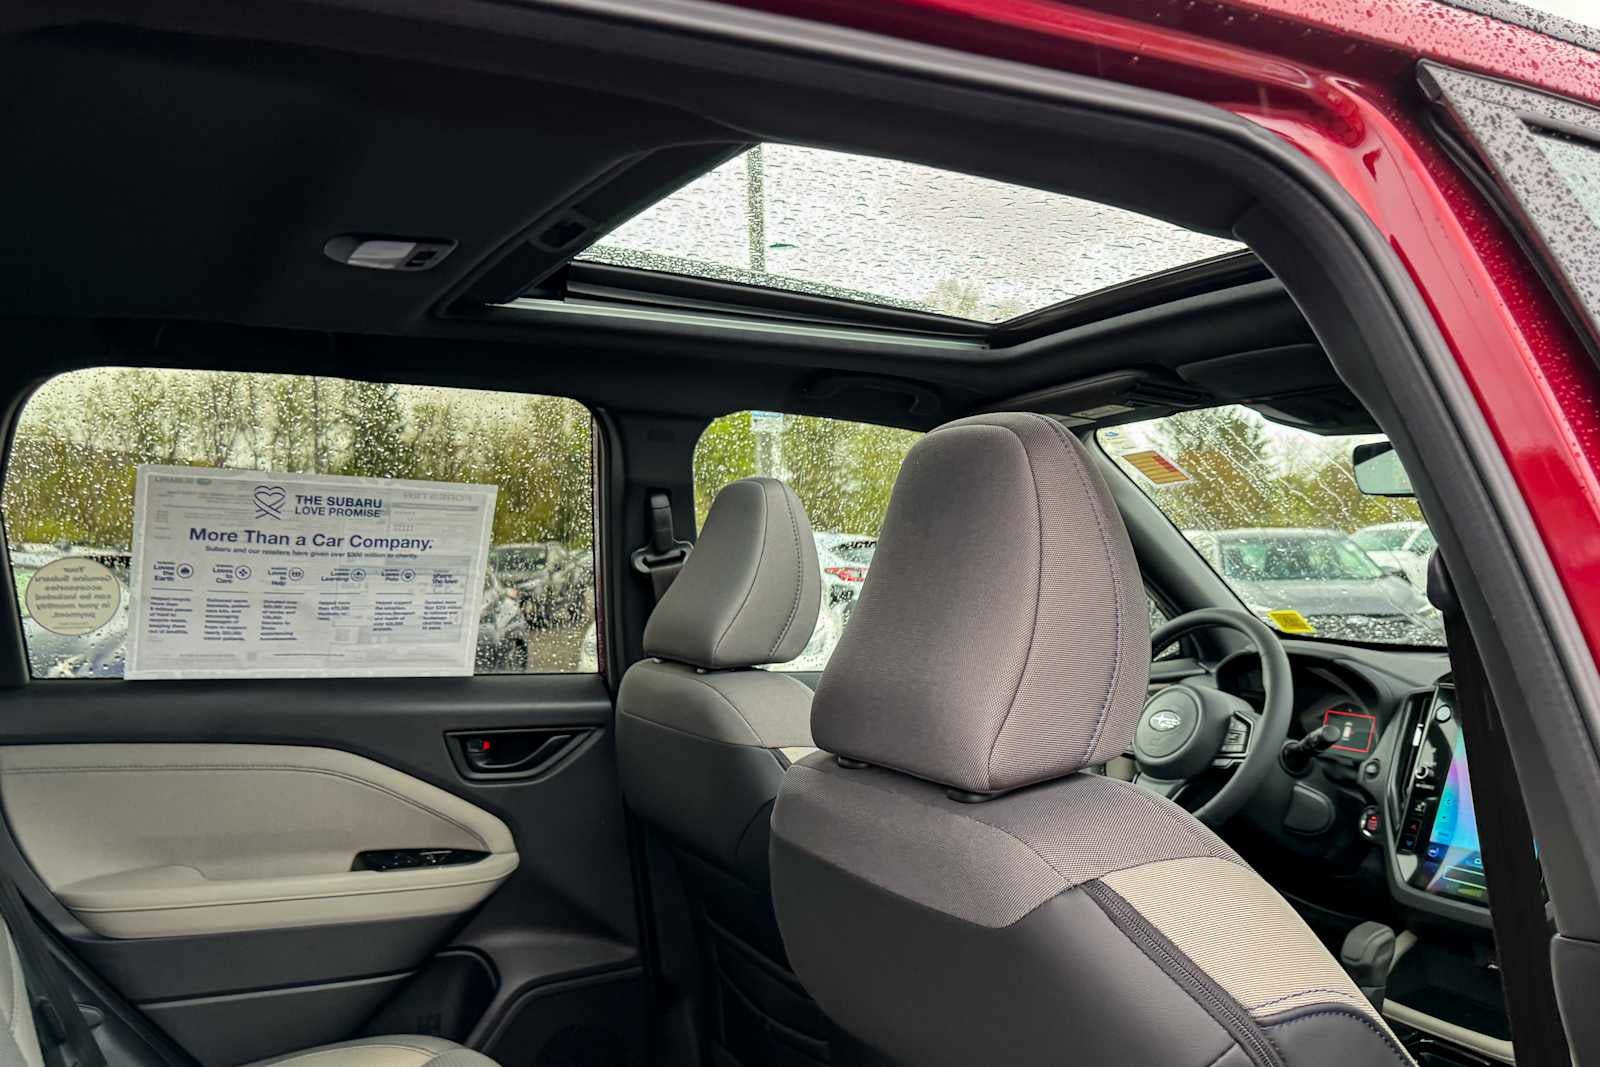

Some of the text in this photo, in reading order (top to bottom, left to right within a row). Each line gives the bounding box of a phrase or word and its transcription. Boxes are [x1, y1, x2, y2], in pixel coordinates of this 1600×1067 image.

[295, 494, 383, 509] THE SUBARU
[294, 506, 382, 518] LOVE PROMISE
[189, 527, 433, 552] More Than a Car Company.
